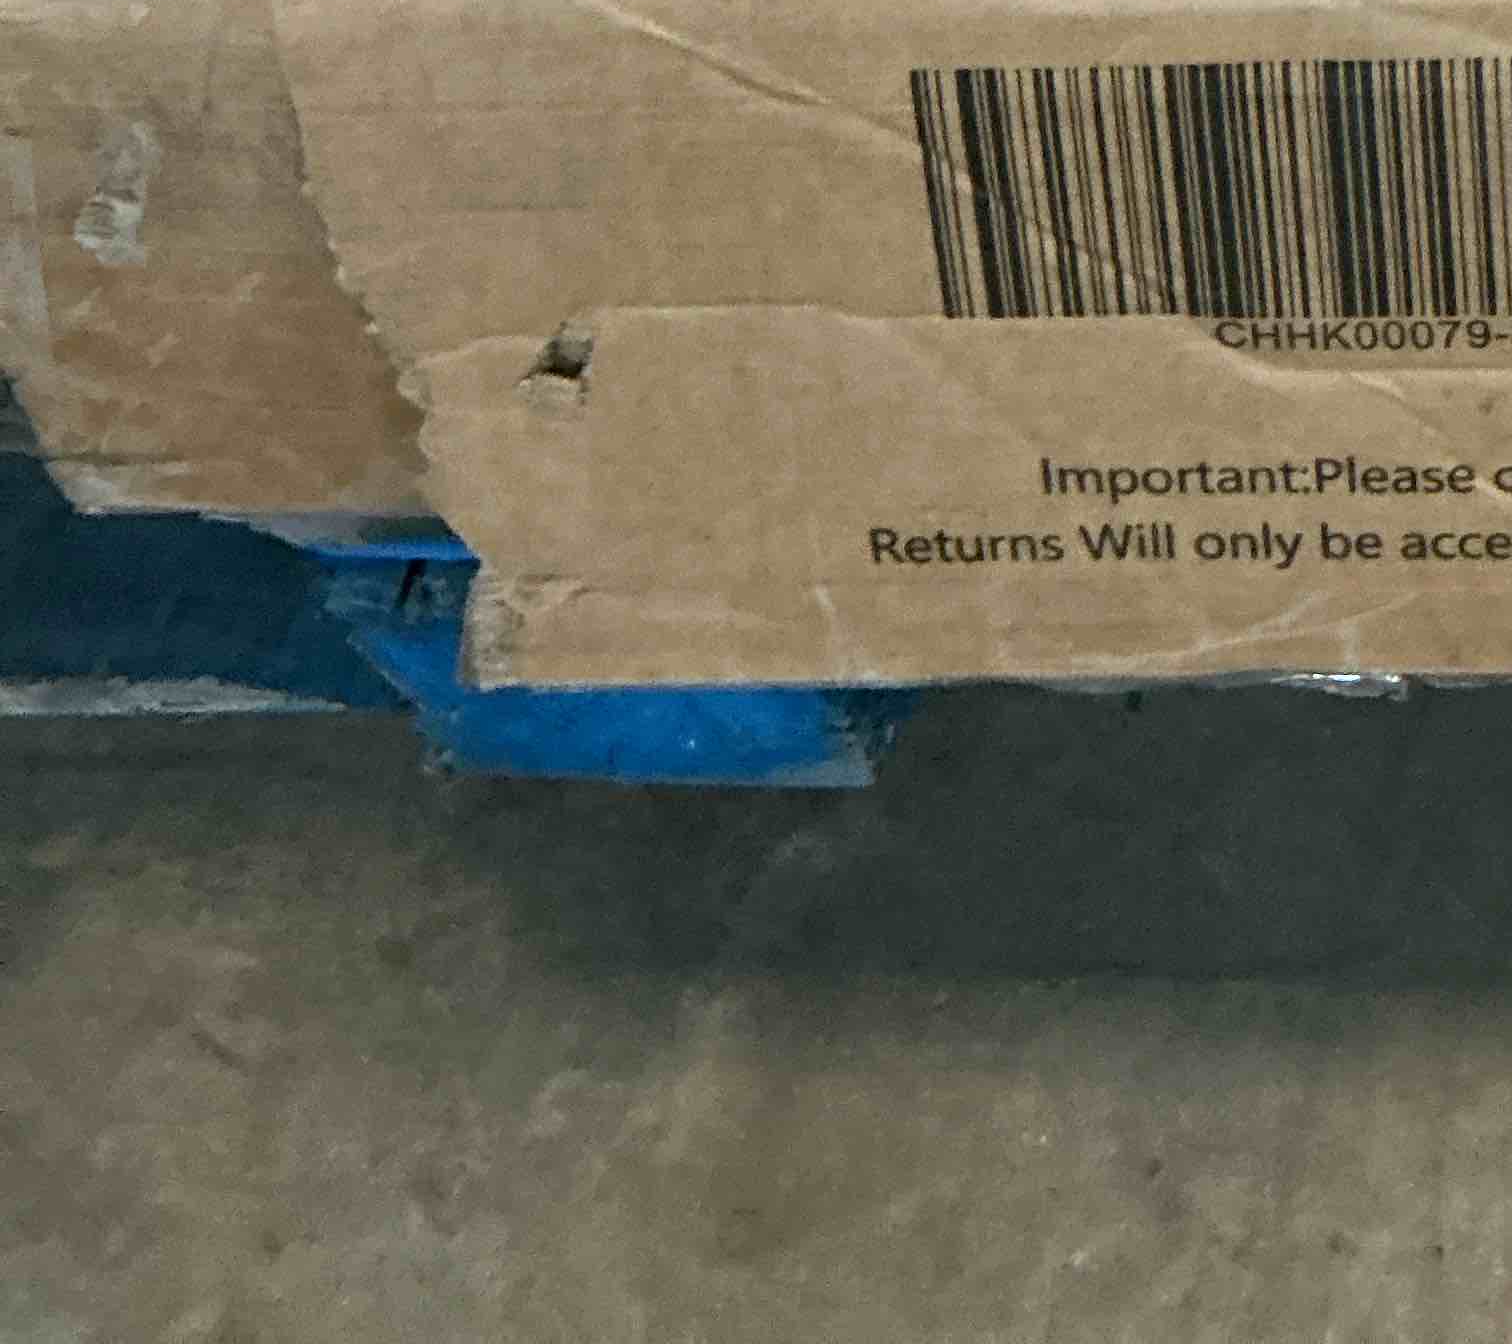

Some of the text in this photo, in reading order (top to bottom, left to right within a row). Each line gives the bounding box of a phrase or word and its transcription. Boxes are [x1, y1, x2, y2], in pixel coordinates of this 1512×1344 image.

[868, 526, 1065, 565] Returns
[1079, 522, 1177, 561] Will
[1194, 521, 1303, 570] only
[1320, 522, 1383, 561] be
